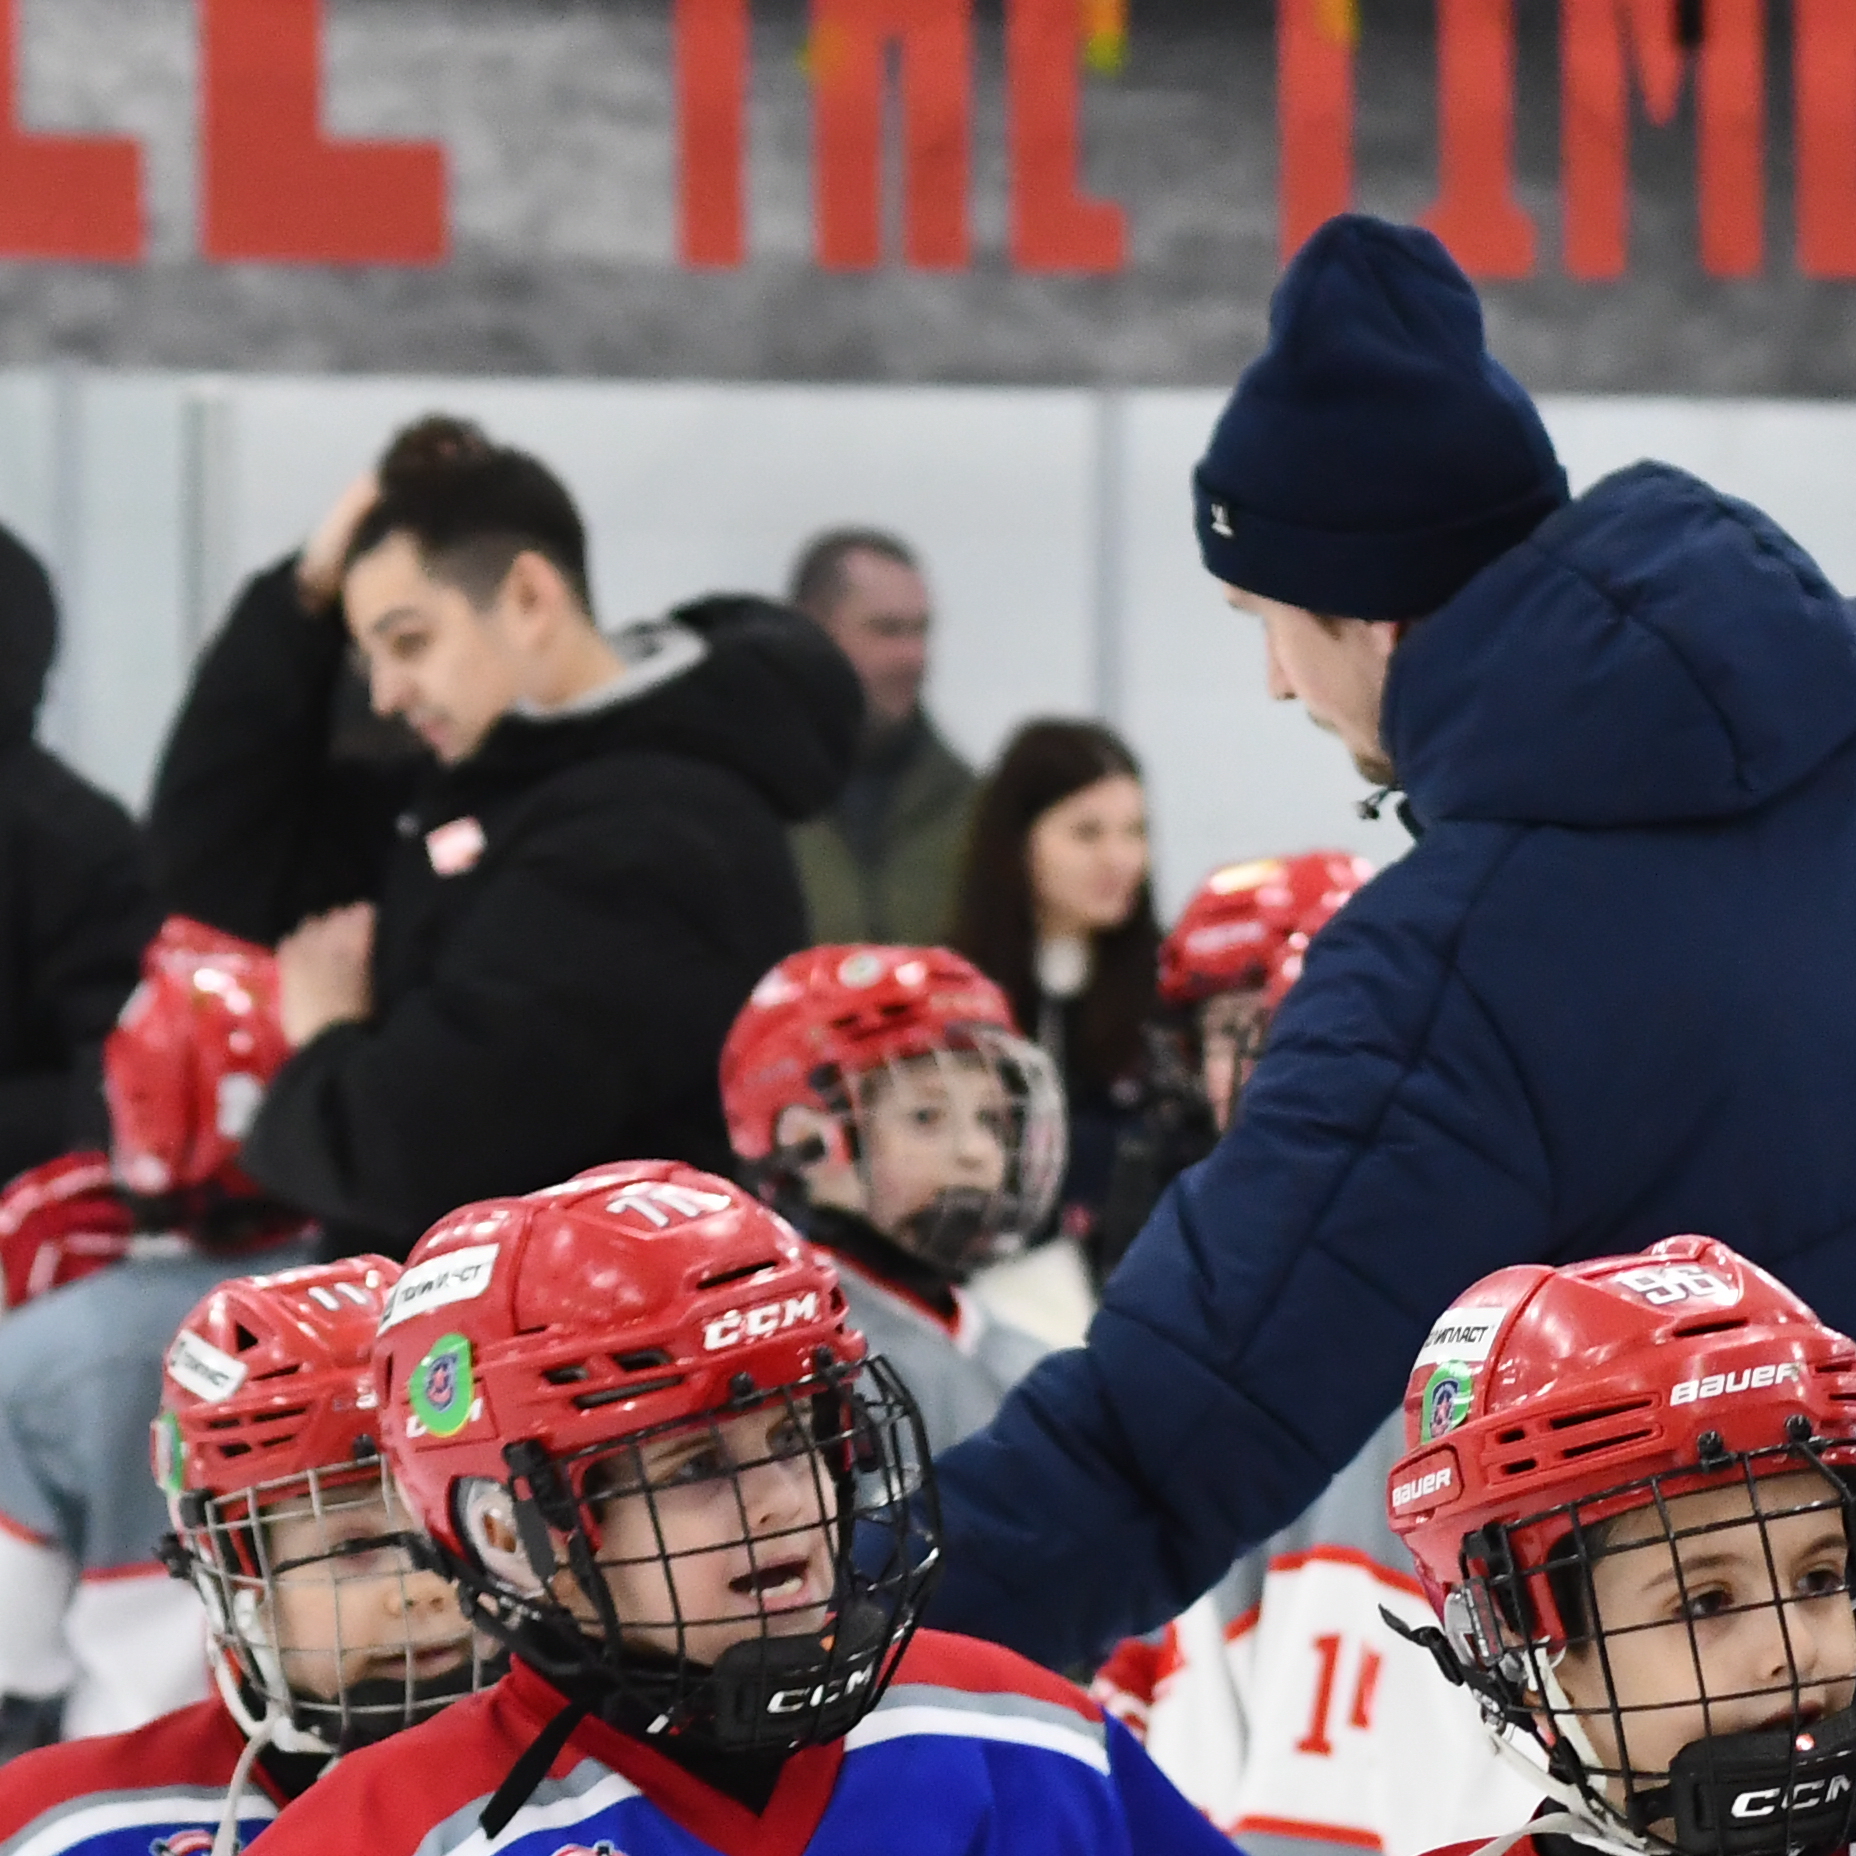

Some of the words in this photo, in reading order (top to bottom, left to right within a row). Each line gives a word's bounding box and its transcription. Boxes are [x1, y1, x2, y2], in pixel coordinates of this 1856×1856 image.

[703, 1292, 818, 1351] CCM
[1669, 1362, 1800, 1406] BAUER
[1392, 1467, 1452, 1506] BAUER
